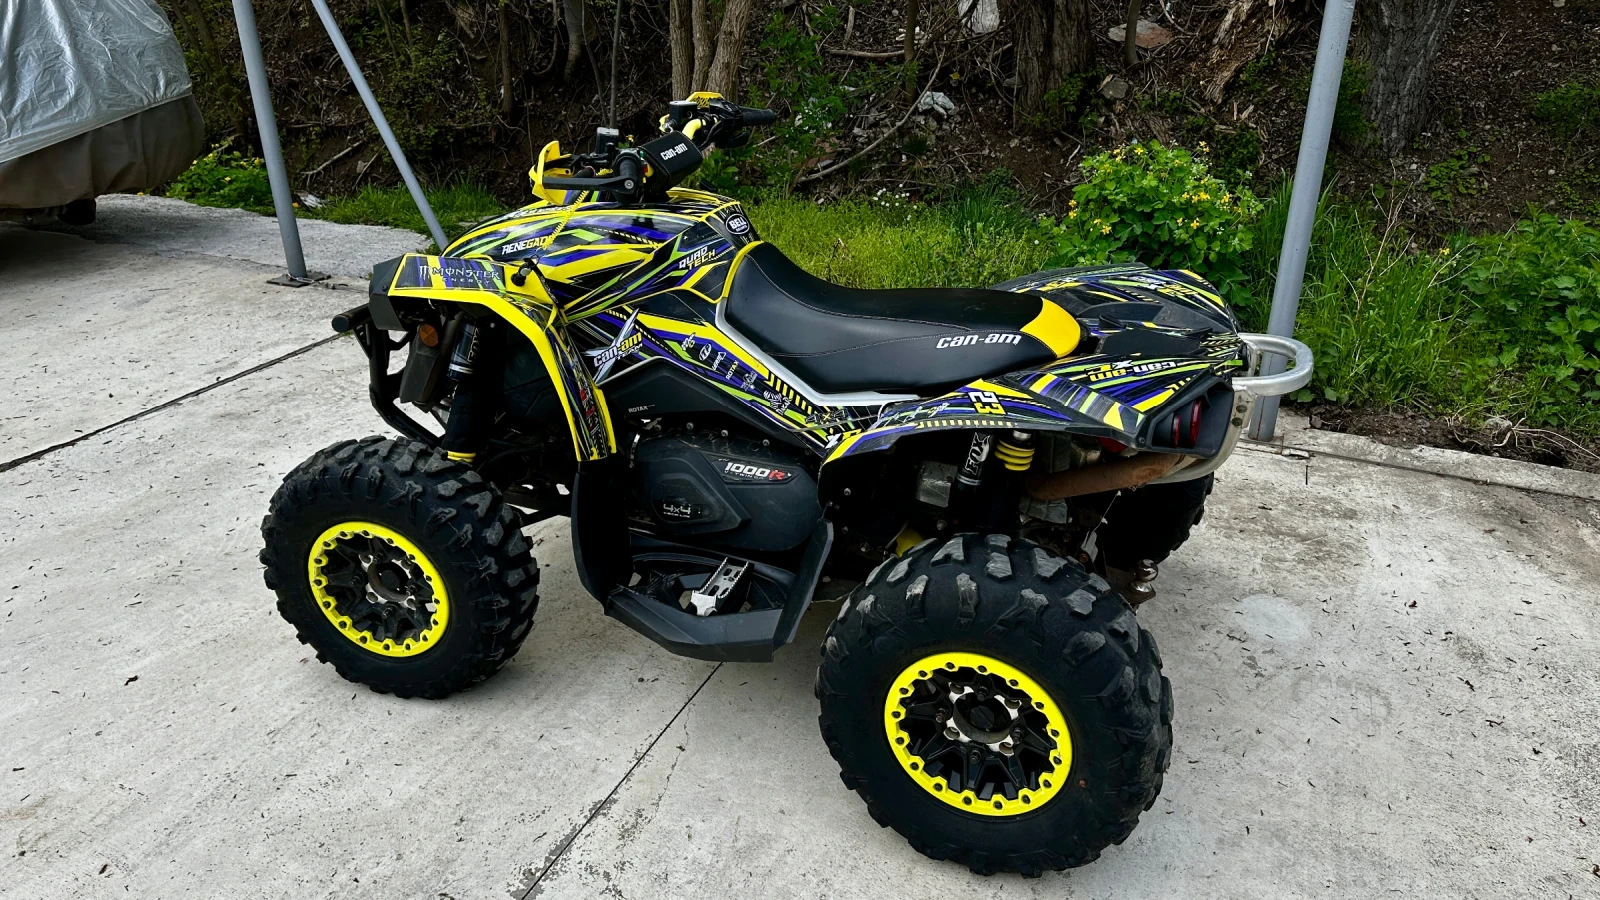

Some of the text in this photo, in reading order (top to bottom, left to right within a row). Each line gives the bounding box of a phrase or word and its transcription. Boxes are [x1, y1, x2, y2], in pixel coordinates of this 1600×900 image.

[660, 143, 688, 160] can-am
[729, 217, 746, 229] BELL
[502, 235, 550, 255] RENEGAD
[679, 246, 708, 269] QUAD
[688, 249, 716, 270] TECH
[443, 277, 490, 285] ENERGY
[593, 332, 642, 367] can-am
[936, 333, 1022, 349] can-am
[615, 343, 643, 360] TEAM
[725, 360, 740, 380] ROTAX
[628, 405, 649, 413] ROTAX
[968, 391, 1007, 415] 23
[724, 462, 786, 480] 1000R
[663, 503, 691, 514] 4x4
